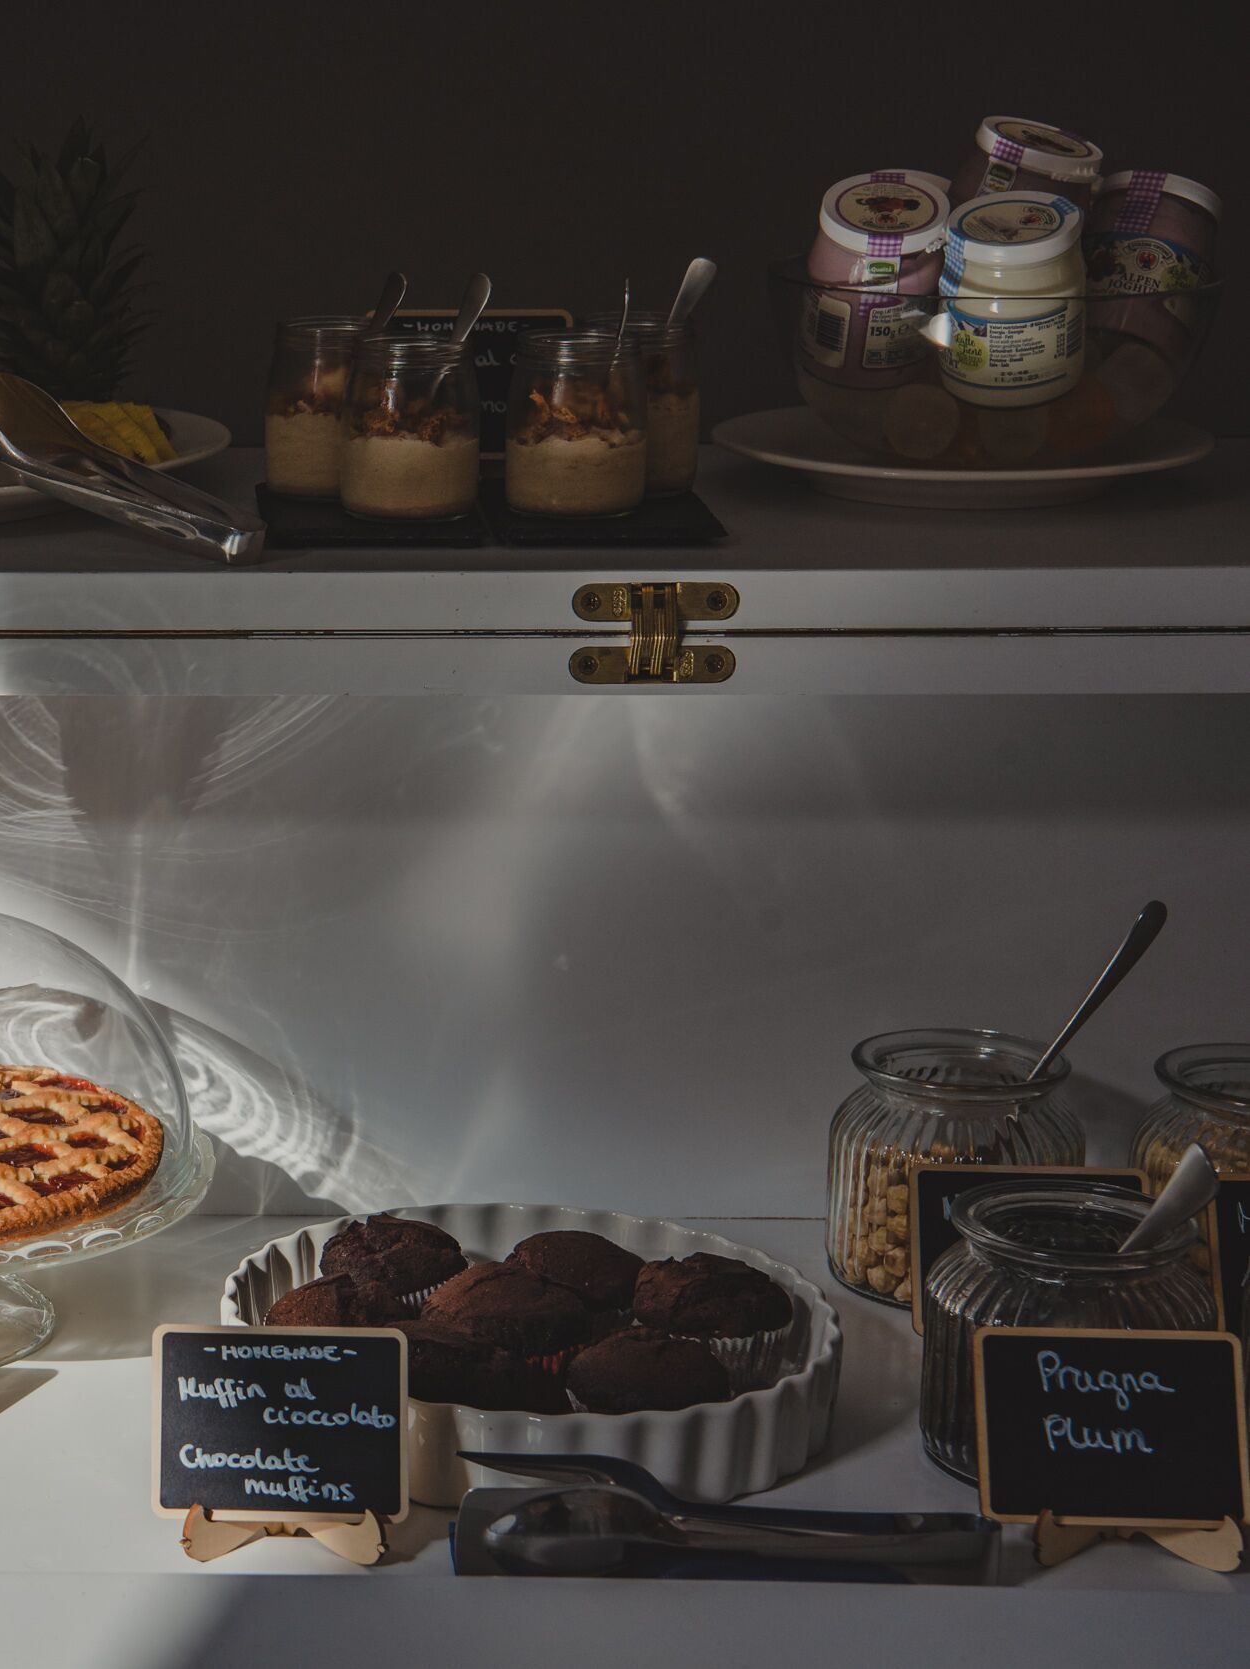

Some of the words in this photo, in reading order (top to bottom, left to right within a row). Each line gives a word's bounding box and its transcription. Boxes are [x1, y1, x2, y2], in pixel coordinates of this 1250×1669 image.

[1120, 271, 1161, 289] ALPEN
[178, 1376, 267, 1409] Muffin
[284, 1377, 317, 1401] al
[1036, 1349, 1176, 1411] Prugna
[1041, 1413, 1154, 1454] Plum
[178, 1443, 321, 1473] Chocolate
[243, 1475, 356, 1503] muffins
